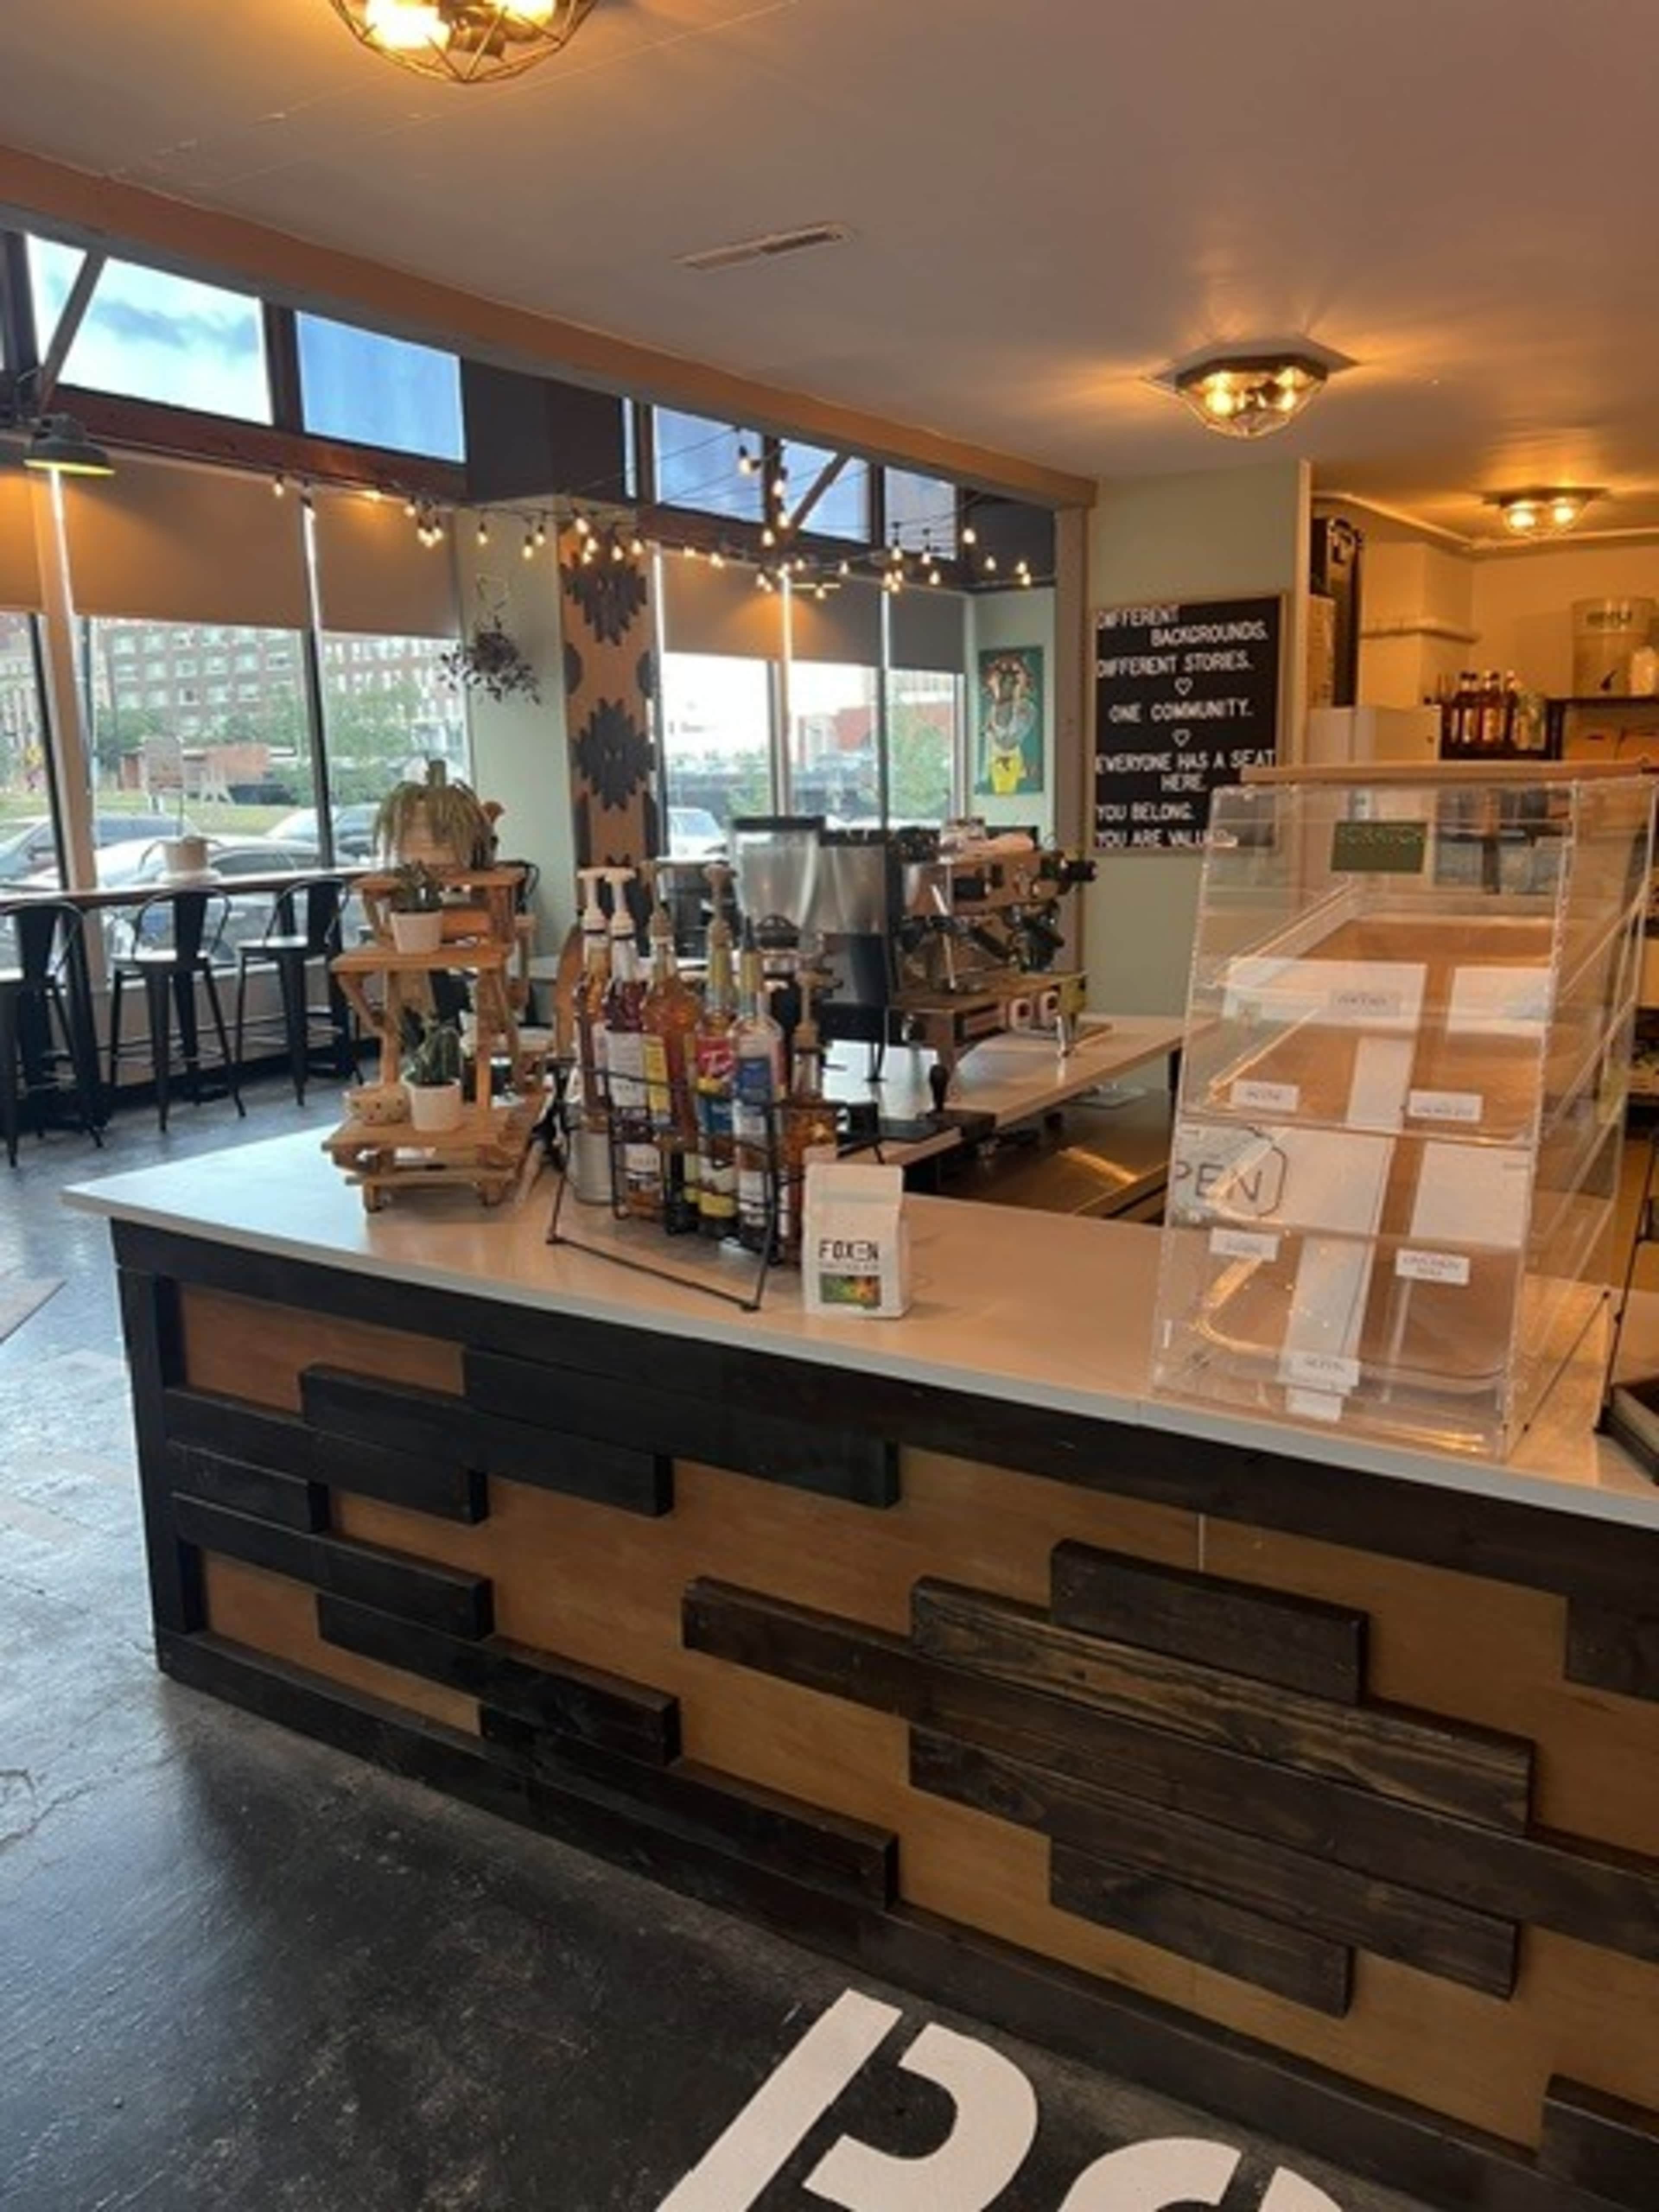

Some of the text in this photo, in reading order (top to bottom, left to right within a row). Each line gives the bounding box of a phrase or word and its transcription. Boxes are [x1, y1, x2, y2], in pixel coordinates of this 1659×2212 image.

[1098, 605, 1179, 629] DIFFERENT
[1151, 620, 1268, 647] BACKGROUNDS.
[1098, 649, 1253, 678] DIFFERENT STORIES.
[1109, 698, 1252, 722] ONE COMMUNITY.
[1096, 749, 1275, 773] EVERYONE HAS A SEAT
[1160, 773, 1208, 792] HERE.
[1096, 804, 1126, 821] YOU
[1096, 828, 1211, 848] YOU ARE VALU
[1173, 1160, 1262, 1203] PEN
[819, 1239, 879, 1262] FOXEN
